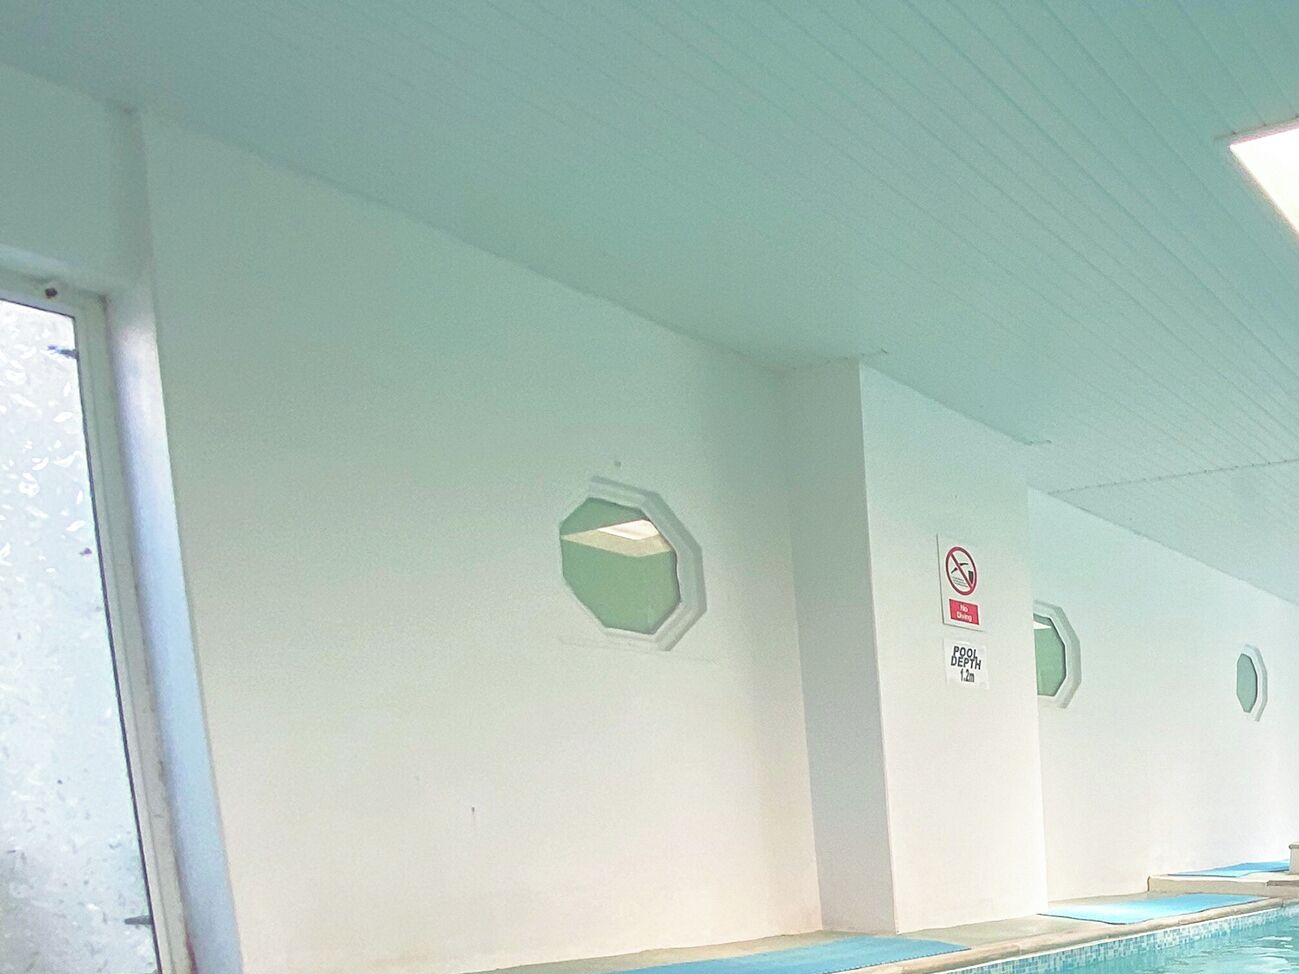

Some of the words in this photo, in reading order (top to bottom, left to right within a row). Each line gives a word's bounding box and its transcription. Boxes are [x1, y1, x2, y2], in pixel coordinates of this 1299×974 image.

[960, 604, 969, 612] No
[957, 611, 973, 622] Diving
[953, 646, 978, 659] POOL
[951, 656, 981, 670] DEPTH
[960, 668, 975, 682] 1.2m
